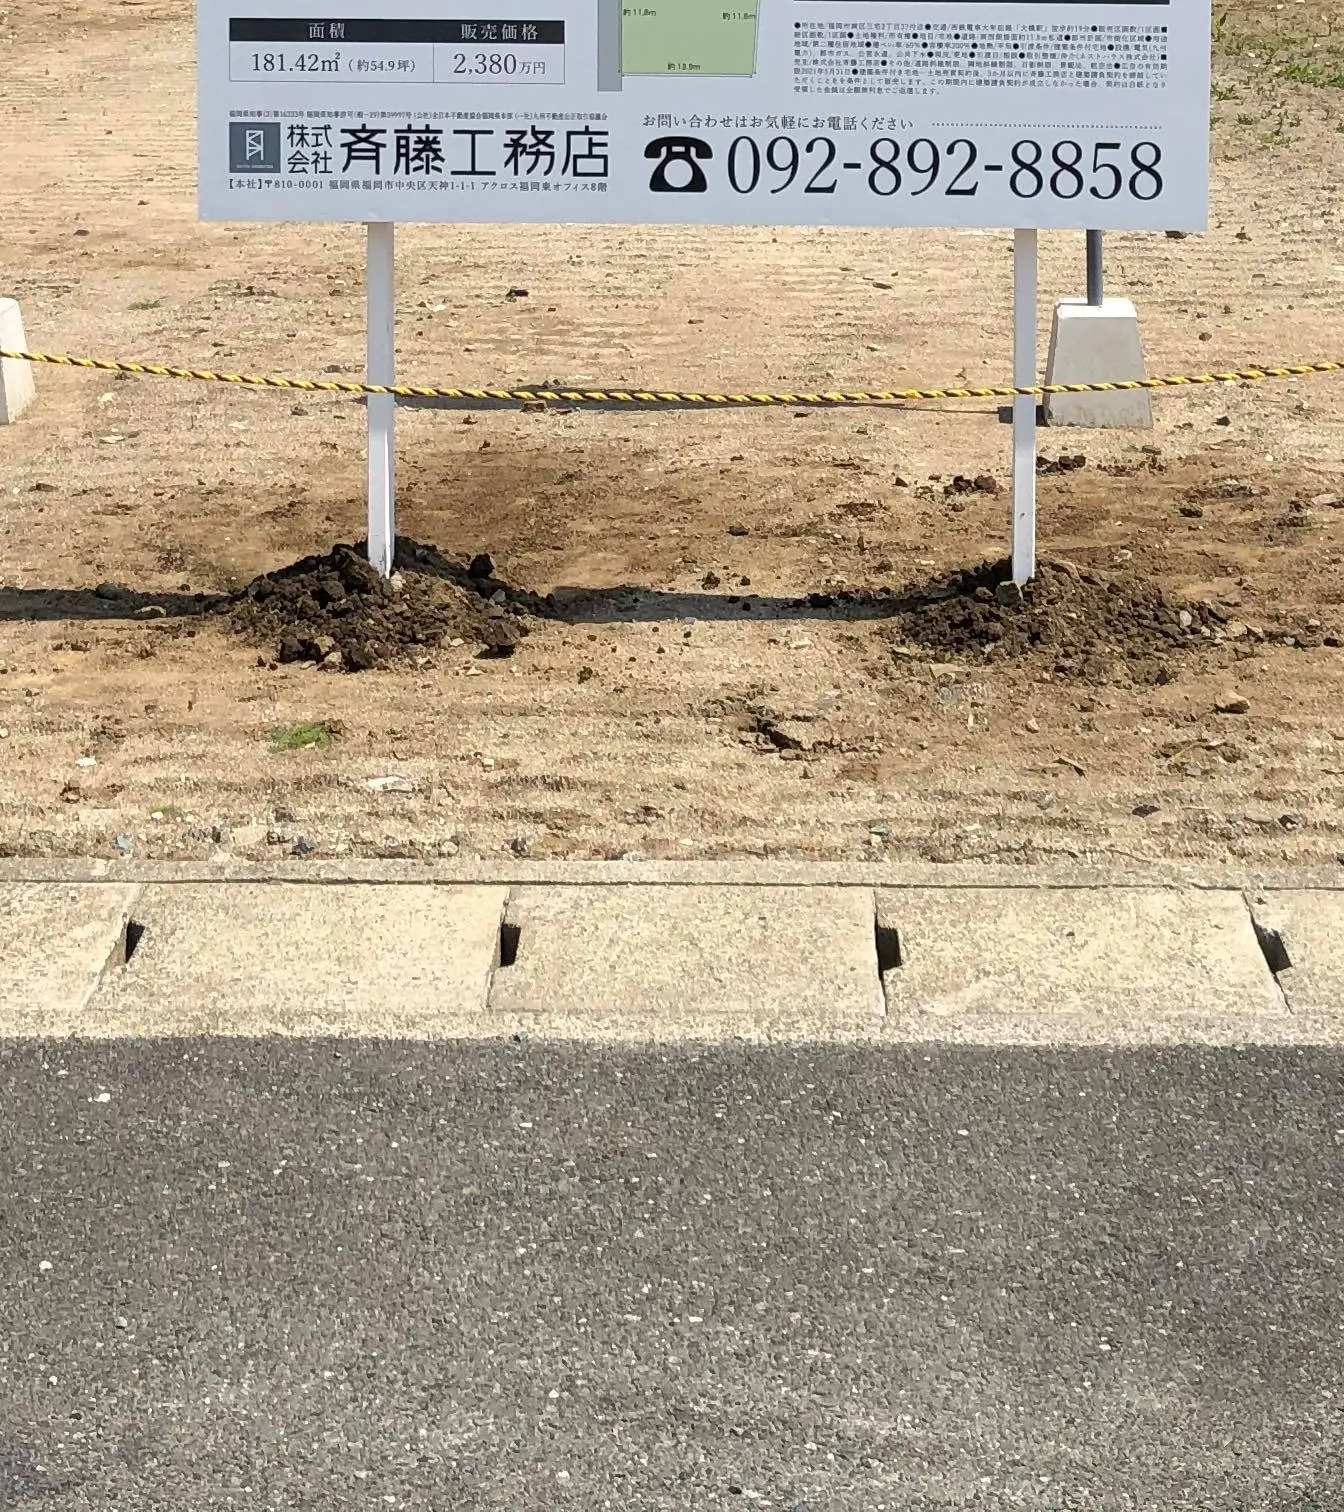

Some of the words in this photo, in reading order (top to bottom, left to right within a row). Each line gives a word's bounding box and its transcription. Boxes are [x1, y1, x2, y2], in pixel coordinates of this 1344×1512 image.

[309, 22, 346, 39] 面積
[461, 23, 540, 41] 販売価格
[453, 53, 547, 76] 2,380万円
[642, 113, 914, 131] お問い合わせはお気軽にお電話ください
[286, 124, 333, 148] 株式
[287, 150, 333, 174] 会社
[340, 123, 609, 178] 斉藤工務店
[727, 135, 1163, 200] 092-892-8858
